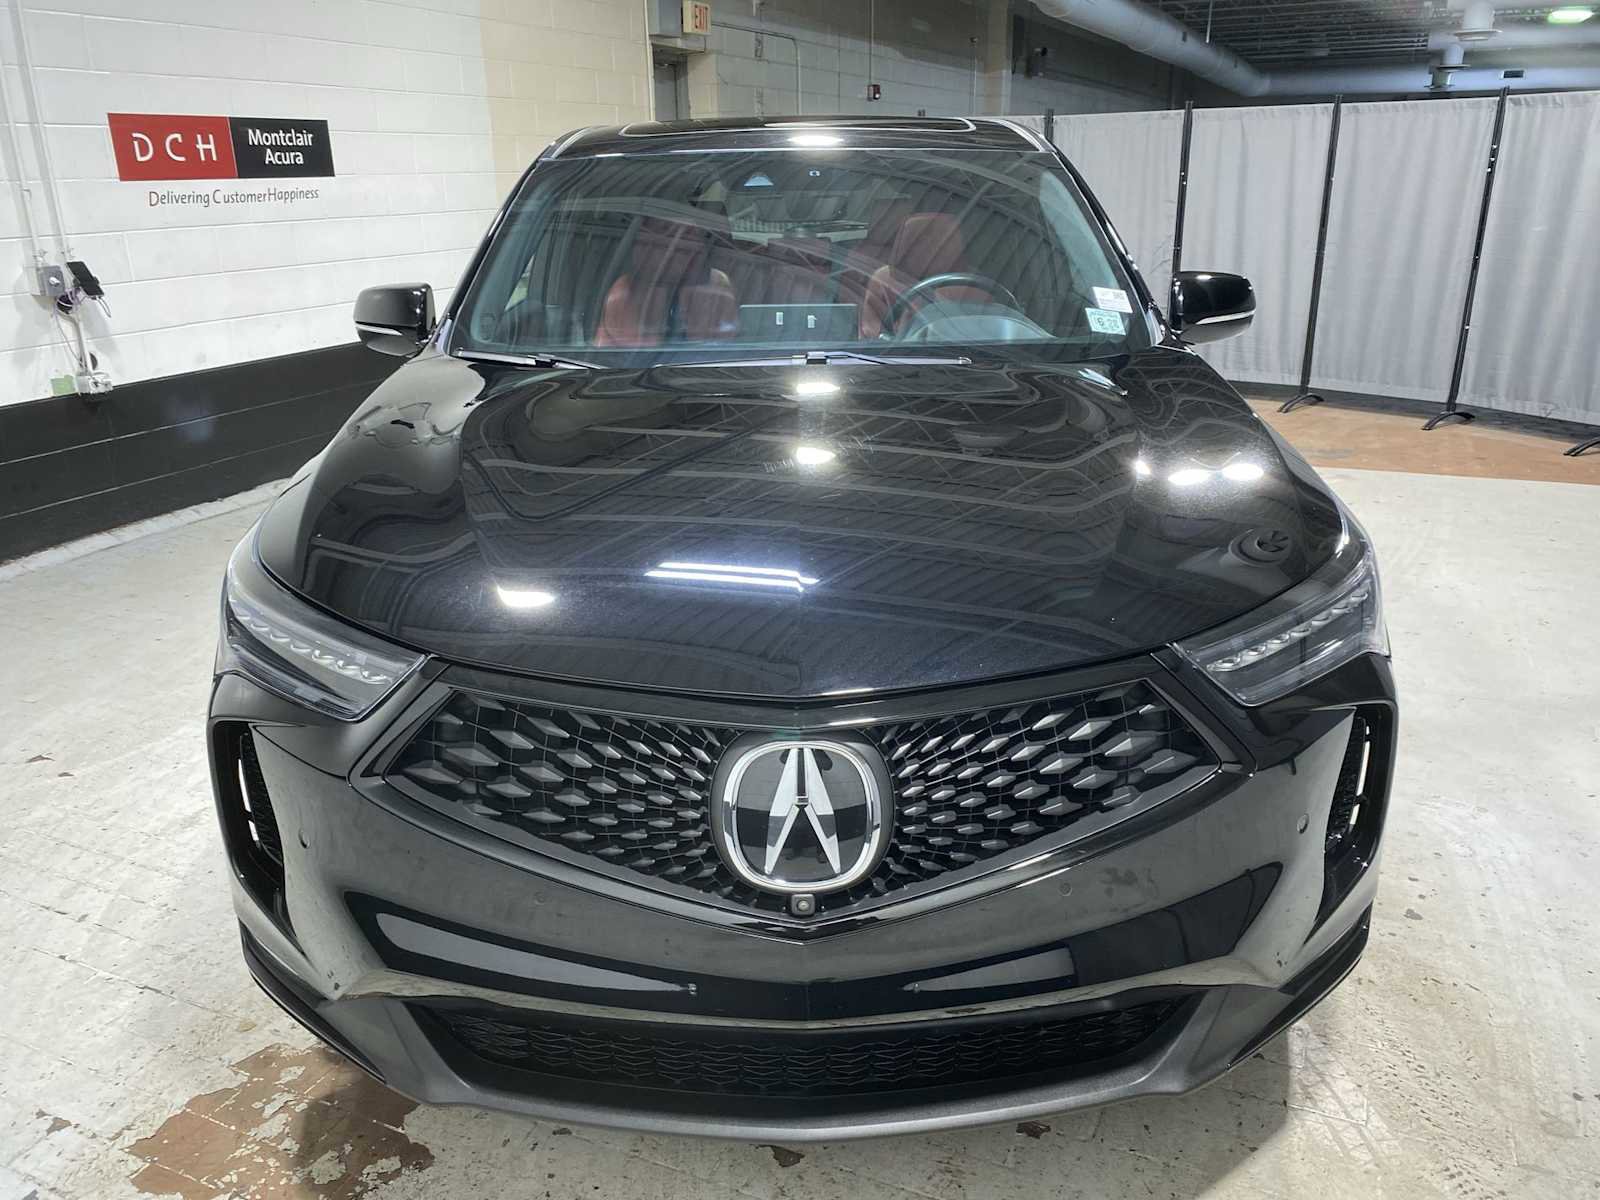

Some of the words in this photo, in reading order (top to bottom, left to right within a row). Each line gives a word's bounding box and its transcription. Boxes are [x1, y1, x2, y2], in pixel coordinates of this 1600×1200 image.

[693, 4, 709, 32] EXIT
[248, 129, 314, 146] Montclair
[264, 149, 304, 165] Acura
[149, 191, 210, 208] Delivering
